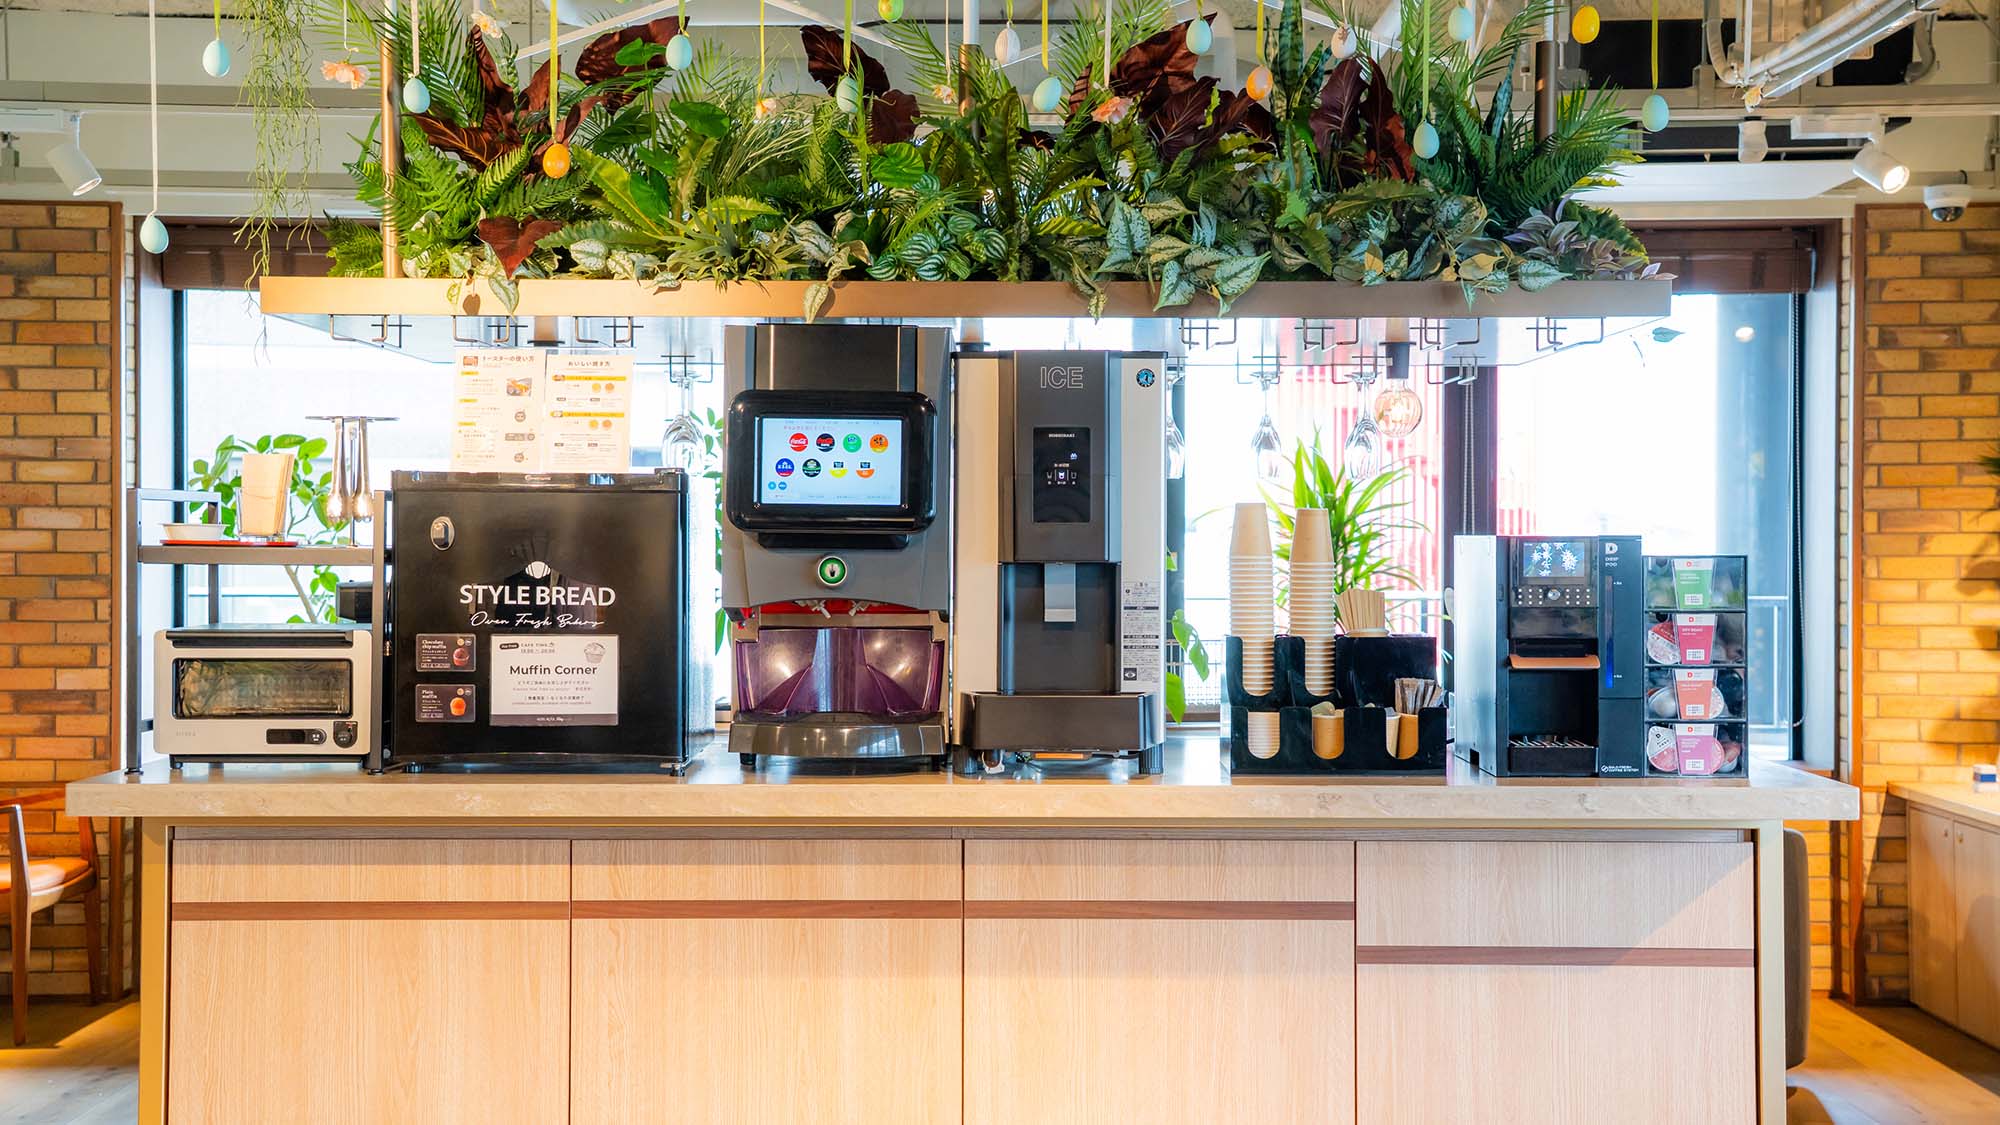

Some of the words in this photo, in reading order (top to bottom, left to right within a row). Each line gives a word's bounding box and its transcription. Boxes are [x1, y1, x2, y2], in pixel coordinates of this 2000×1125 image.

[1040, 366, 1084, 389] ICE
[459, 584, 531, 605] STYLE
[536, 586, 616, 606] BREAD
[470, 611, 510, 627] Oven
[514, 612, 552, 629] Fresh
[556, 614, 605, 629] Bakery
[509, 664, 551, 675] Muffin
[554, 665, 598, 675] Corner
